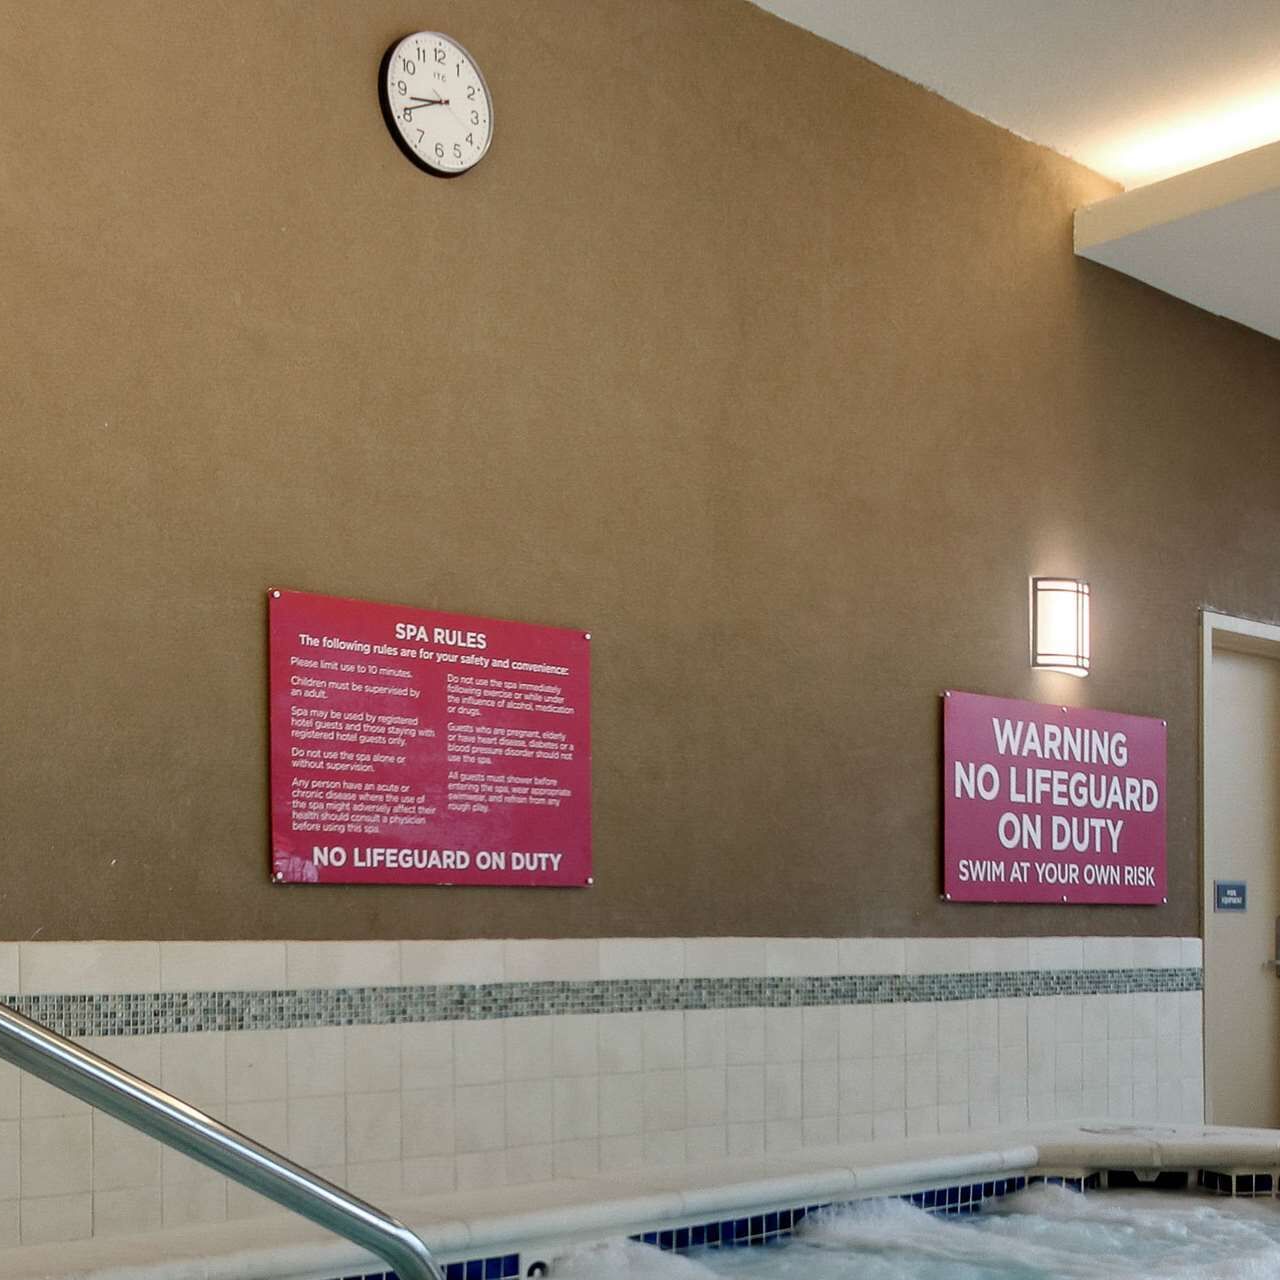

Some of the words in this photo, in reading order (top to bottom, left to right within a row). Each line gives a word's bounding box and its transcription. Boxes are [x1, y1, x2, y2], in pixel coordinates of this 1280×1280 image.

[416, 47, 426, 63] 11
[434, 47, 447, 65] 12
[402, 58, 416, 76] 10
[455, 63, 460, 77] 1
[397, 80, 407, 96] 9
[466, 85, 476, 101] 2
[403, 107, 413, 123] 8
[470, 110, 479, 126] 3
[416, 128, 425, 144] 7
[465, 132, 473, 147] 4
[434, 142, 445, 158] 6
[453, 143, 462, 159] 5
[395, 623, 428, 642] SPA
[433, 628, 487, 649] RULES
[299, 634, 319, 646] The
[322, 636, 370, 654] following
[373, 643, 398, 656] rules
[400, 649, 417, 658] are
[419, 648, 434, 659] for
[436, 652, 458, 663] your
[460, 652, 489, 668] safety
[491, 657, 510, 668] and
[290, 657, 318, 668] Please
[320, 659, 338, 670] limit
[340, 664, 355, 672] use
[357, 664, 366, 673] to
[368, 665, 377, 674] 10
[290, 676, 326, 688] Children
[328, 680, 350, 690] must
[352, 682, 362, 692] be
[364, 683, 408, 697] supervised
[410, 687, 420, 698] by
[290, 688, 302, 696] an
[291, 706, 308, 717] Spa
[310, 709, 328, 719] may
[330, 710, 341, 719] be
[343, 711, 364, 721] used
[366, 713, 376, 724] by
[378, 715, 418, 726] registered
[291, 717, 313, 727] hotel
[315, 720, 343, 730] guests
[345, 723, 361, 731] and
[363, 723, 386, 733] those
[387, 726, 416, 738] staying
[418, 729, 435, 737] with
[291, 729, 334, 740] registered
[336, 731, 358, 742] hotel
[359, 734, 386, 744] guests
[992, 717, 1128, 767] WARNING
[291, 747, 305, 757] Do
[306, 748, 321, 757] not
[323, 751, 338, 759] use
[340, 750, 354, 760] the
[356, 753, 371, 763] spa
[372, 754, 394, 763] alone
[291, 759, 324, 769] without
[292, 778, 309, 788] Any
[311, 780, 341, 790] person
[342, 780, 362, 790] have
[377, 783, 399, 792] acute
[954, 761, 1000, 801] NO
[1009, 766, 1159, 813] LIFEGUARD
[291, 790, 323, 799] chronic
[326, 790, 357, 801] disease
[358, 793, 384, 802] where
[385, 793, 399, 802] the
[401, 795, 415, 803] use
[416, 794, 425, 804] of
[292, 800, 306, 809] the
[308, 802, 324, 811] spa
[326, 801, 350, 812] might
[352, 803, 391, 814] adversely
[392, 805, 417, 814] affect
[418, 806, 436, 815] their
[292, 811, 319, 820] health
[321, 812, 349, 821] should
[351, 814, 380, 823] consult
[389, 815, 426, 825] physician
[292, 821, 320, 831] before
[322, 823, 345, 833] using
[347, 823, 362, 832] this
[998, 812, 1041, 850] ON
[1051, 815, 1124, 853] DUTY
[313, 846, 346, 867] NO
[353, 847, 470, 869] LIFEGUARD
[476, 851, 505, 870] ON
[511, 852, 562, 871] DUTY
[958, 859, 1005, 883] SWIM
[1010, 861, 1030, 883] AT
[1034, 862, 1079, 885] YOUR
[1083, 864, 1120, 885] OWN
[1124, 866, 1156, 887] RISK
